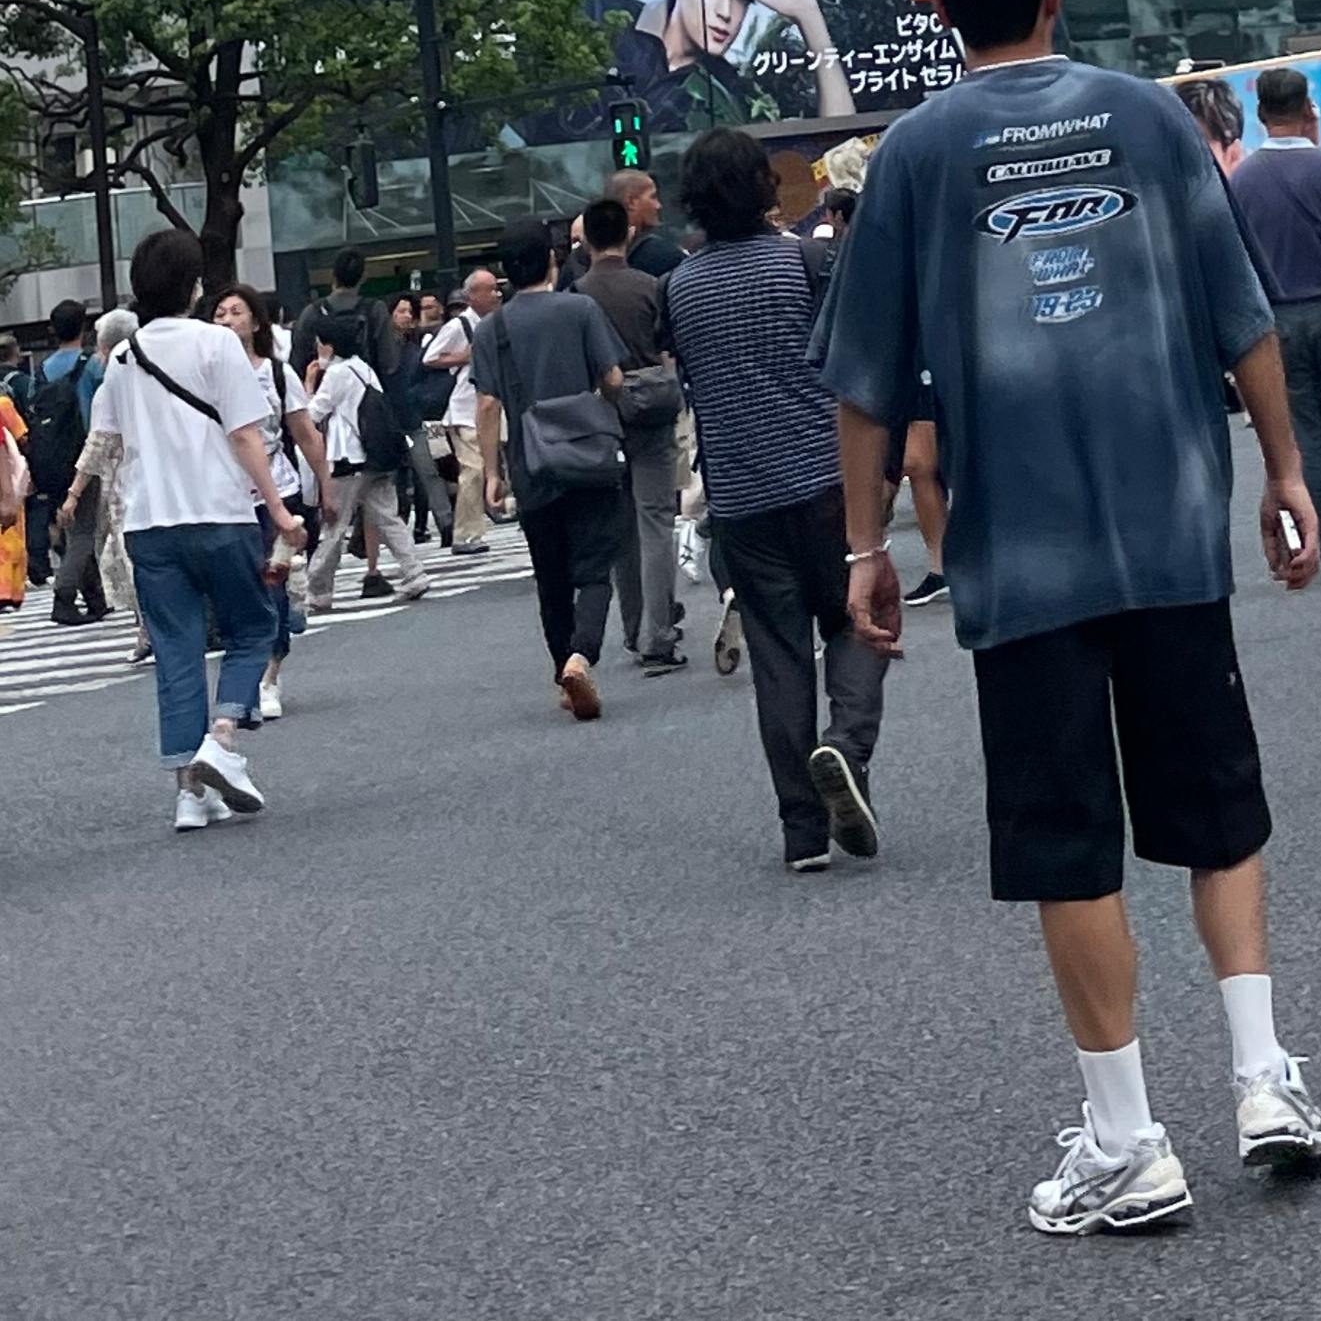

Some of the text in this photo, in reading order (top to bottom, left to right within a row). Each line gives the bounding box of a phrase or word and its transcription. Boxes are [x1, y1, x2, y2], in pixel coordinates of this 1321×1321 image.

[896, 13, 944, 37] ビタC
[753, 38, 957, 76] グリーンティーエンザイム
[1002, 113, 1112, 143] FROMWHAT
